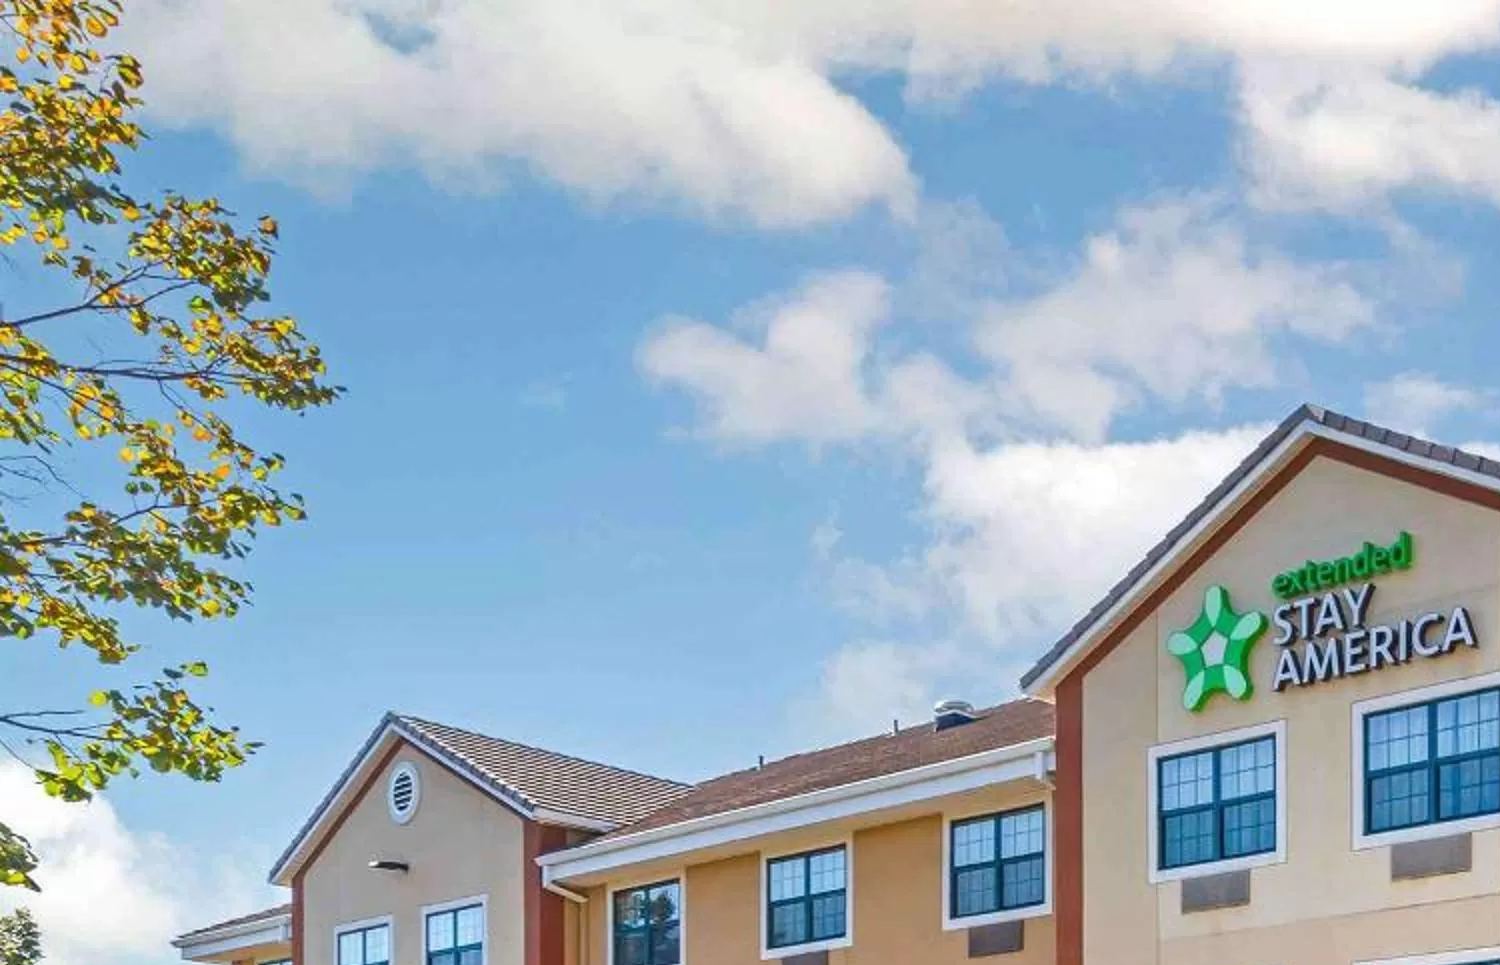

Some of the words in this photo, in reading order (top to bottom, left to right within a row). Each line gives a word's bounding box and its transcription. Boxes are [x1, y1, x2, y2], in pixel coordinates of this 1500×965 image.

[1272, 531, 1414, 598] extended
[1273, 583, 1375, 646] STAY
[1272, 607, 1478, 692] AMERICA
